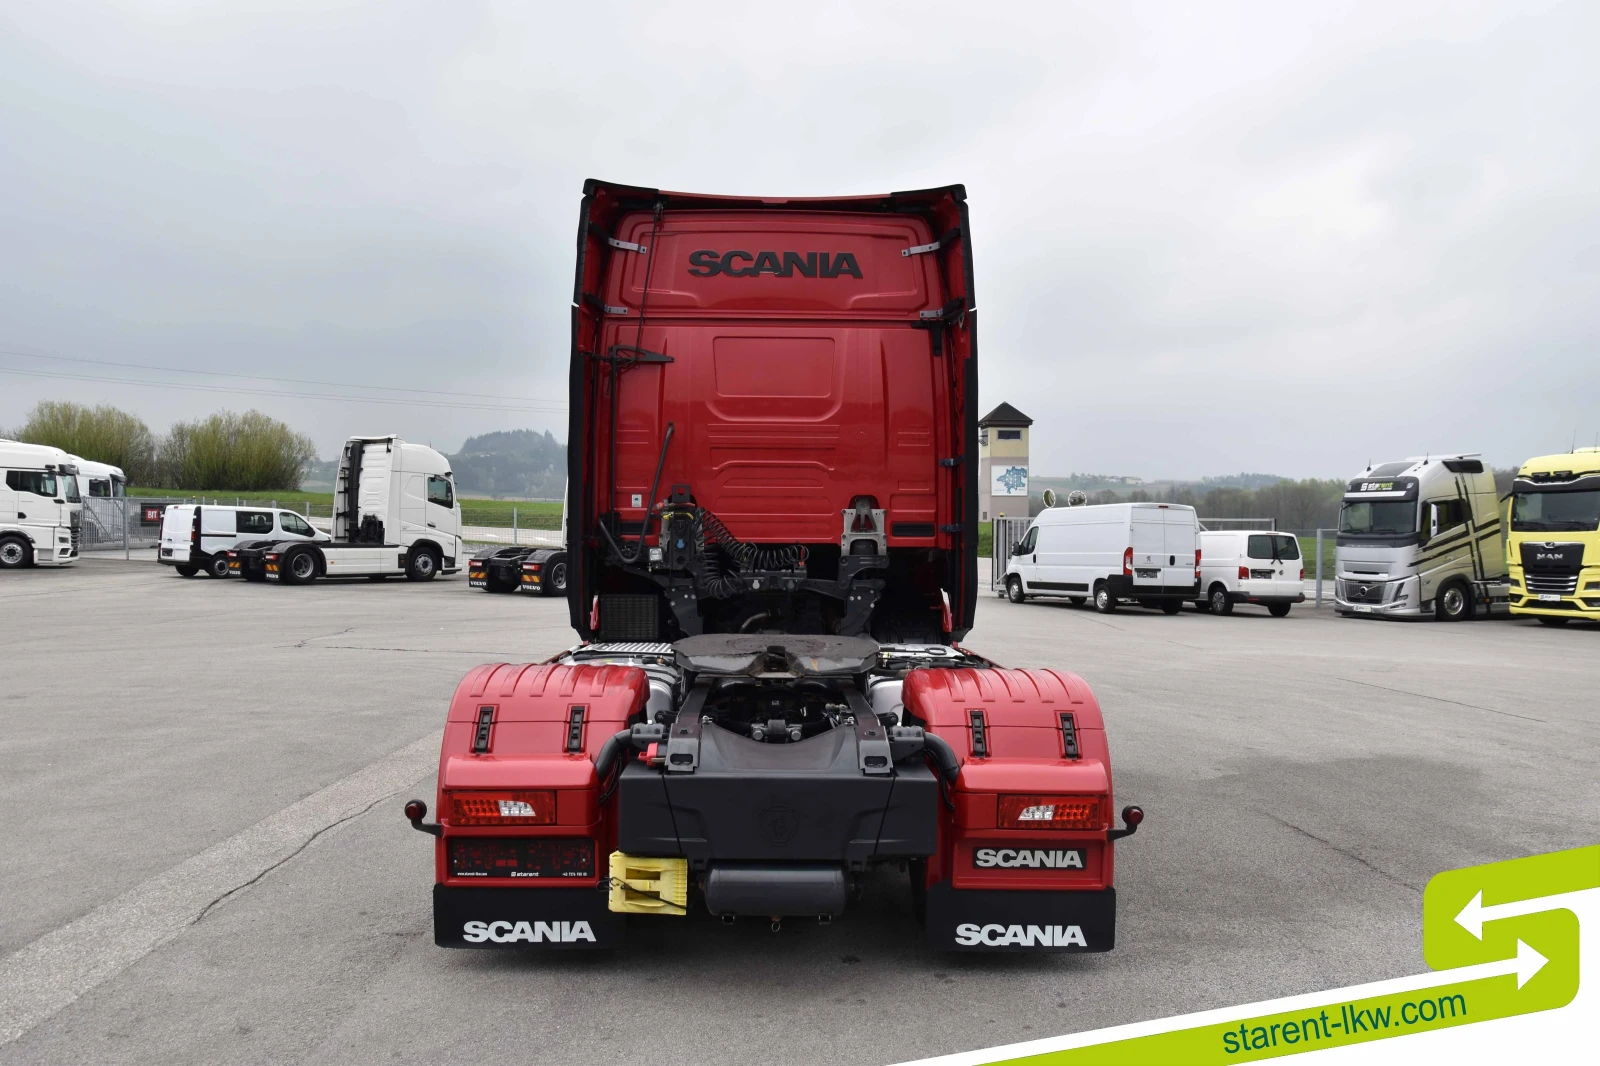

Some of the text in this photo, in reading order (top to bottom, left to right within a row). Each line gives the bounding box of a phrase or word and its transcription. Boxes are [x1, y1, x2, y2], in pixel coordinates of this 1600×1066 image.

[687, 249, 864, 279] SCANIA
[975, 849, 1083, 869] SCANIA
[463, 920, 596, 943] SCANIA
[954, 923, 1087, 947] SCANIA
